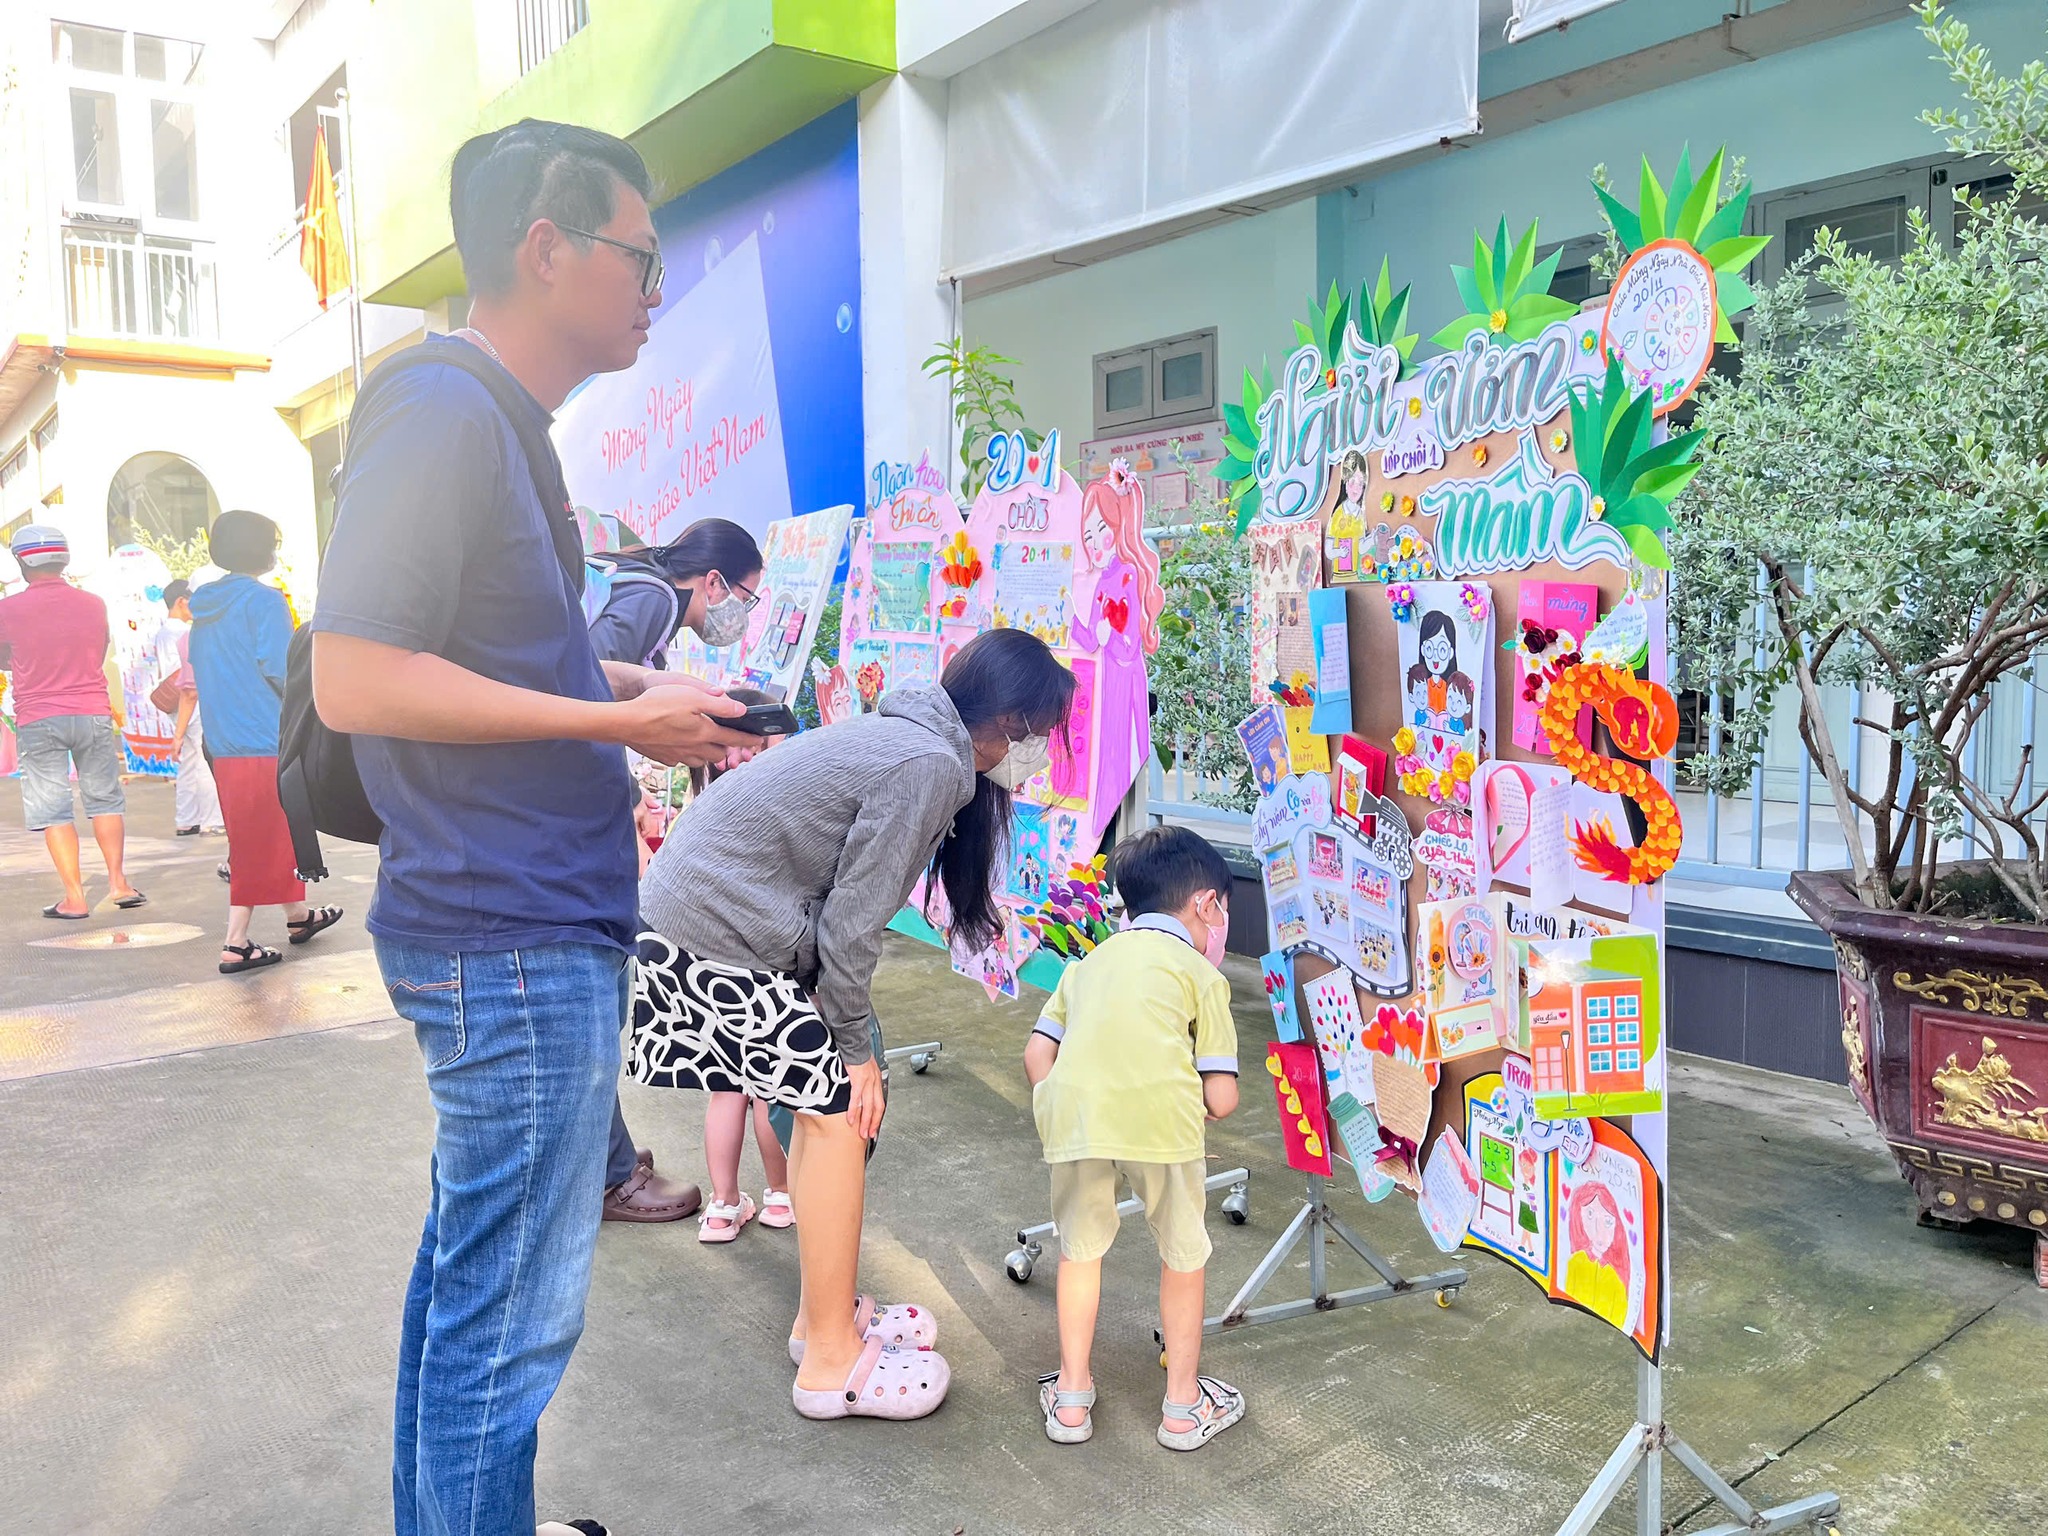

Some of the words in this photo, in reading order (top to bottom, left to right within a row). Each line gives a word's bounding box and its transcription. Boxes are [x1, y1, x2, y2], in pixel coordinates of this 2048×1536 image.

[1633, 277, 1662, 312] 20/11
[601, 421, 647, 475] Mừng
[646, 376, 695, 449] Ngày
[680, 425, 722, 496] Việt
[717, 413, 767, 469] Nam
[1402, 433, 1427, 471] CHỒI
[1430, 443, 1439, 467] 1
[1037, 498, 1050, 530] 3
[1548, 588, 1588, 622] mừng
[1505, 901, 1531, 934] tri
[1485, 1138, 1491, 1150] 1
[1493, 1142, 1501, 1154] 2
[1503, 1147, 1510, 1161] 3
